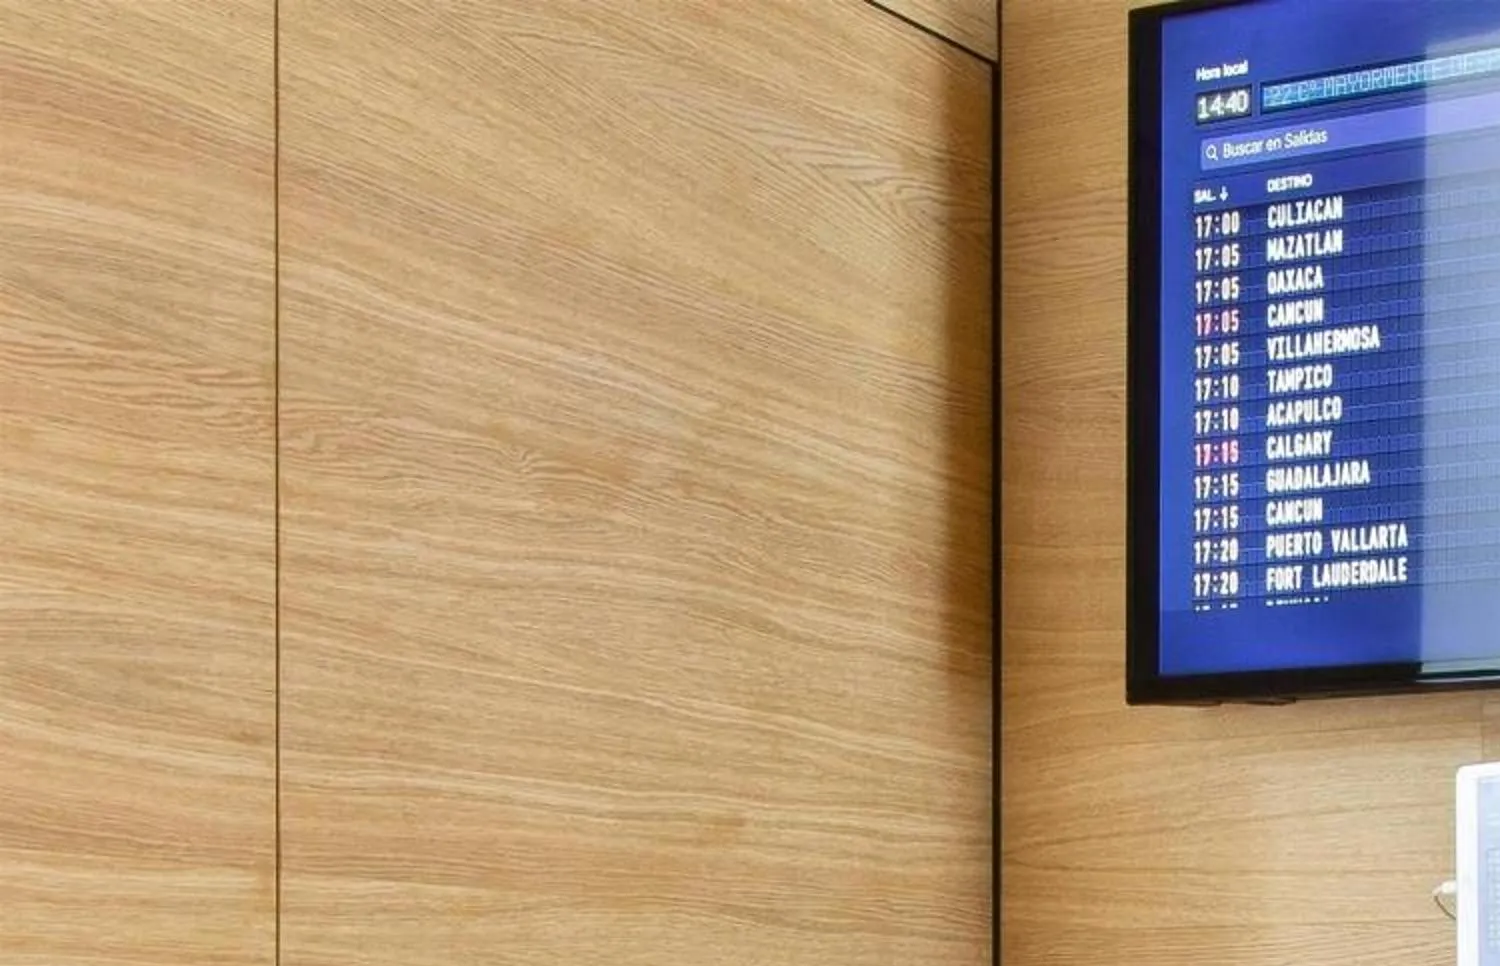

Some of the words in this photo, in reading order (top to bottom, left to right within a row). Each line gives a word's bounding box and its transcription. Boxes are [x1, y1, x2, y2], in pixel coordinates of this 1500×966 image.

[1196, 65, 1221, 82] Hora
[1223, 60, 1248, 79] local
[1197, 88, 1248, 120] 14:40
[1223, 138, 1264, 160] Buscar
[1265, 136, 1282, 151] en
[1284, 130, 1328, 150] Salidas
[1267, 173, 1313, 193] DESTINO
[1195, 211, 1240, 239] 17:00
[1267, 196, 1343, 229] CULIACAN
[1195, 243, 1240, 271] 17:05
[1267, 229, 1343, 262] MAZATLAN
[1195, 276, 1240, 304] 17:05
[1267, 265, 1323, 295] OAXACA
[1267, 298, 1323, 328] CANCUN
[1195, 342, 1240, 369] 17:05
[1267, 324, 1380, 360] VILLAHERMOSA
[1195, 374, 1240, 402] 17:10
[1267, 363, 1333, 393] TAMPICO
[1195, 408, 1240, 434] 17:10
[1266, 395, 1342, 427] ACAPULCO
[1266, 430, 1332, 460] CALGARY
[1195, 473, 1240, 499] 17:15
[1266, 460, 1371, 493] GUADALAJARA
[1195, 505, 1240, 532] 17:15
[1266, 497, 1323, 526] CANCUN
[1195, 538, 1240, 564] 17:20
[1266, 531, 1321, 559] PUERTO
[1331, 523, 1408, 553] VALLARTA
[1195, 571, 1240, 596] 17:20
[1266, 565, 1303, 592] FORT
[1312, 557, 1408, 589] LAUDERDALE
